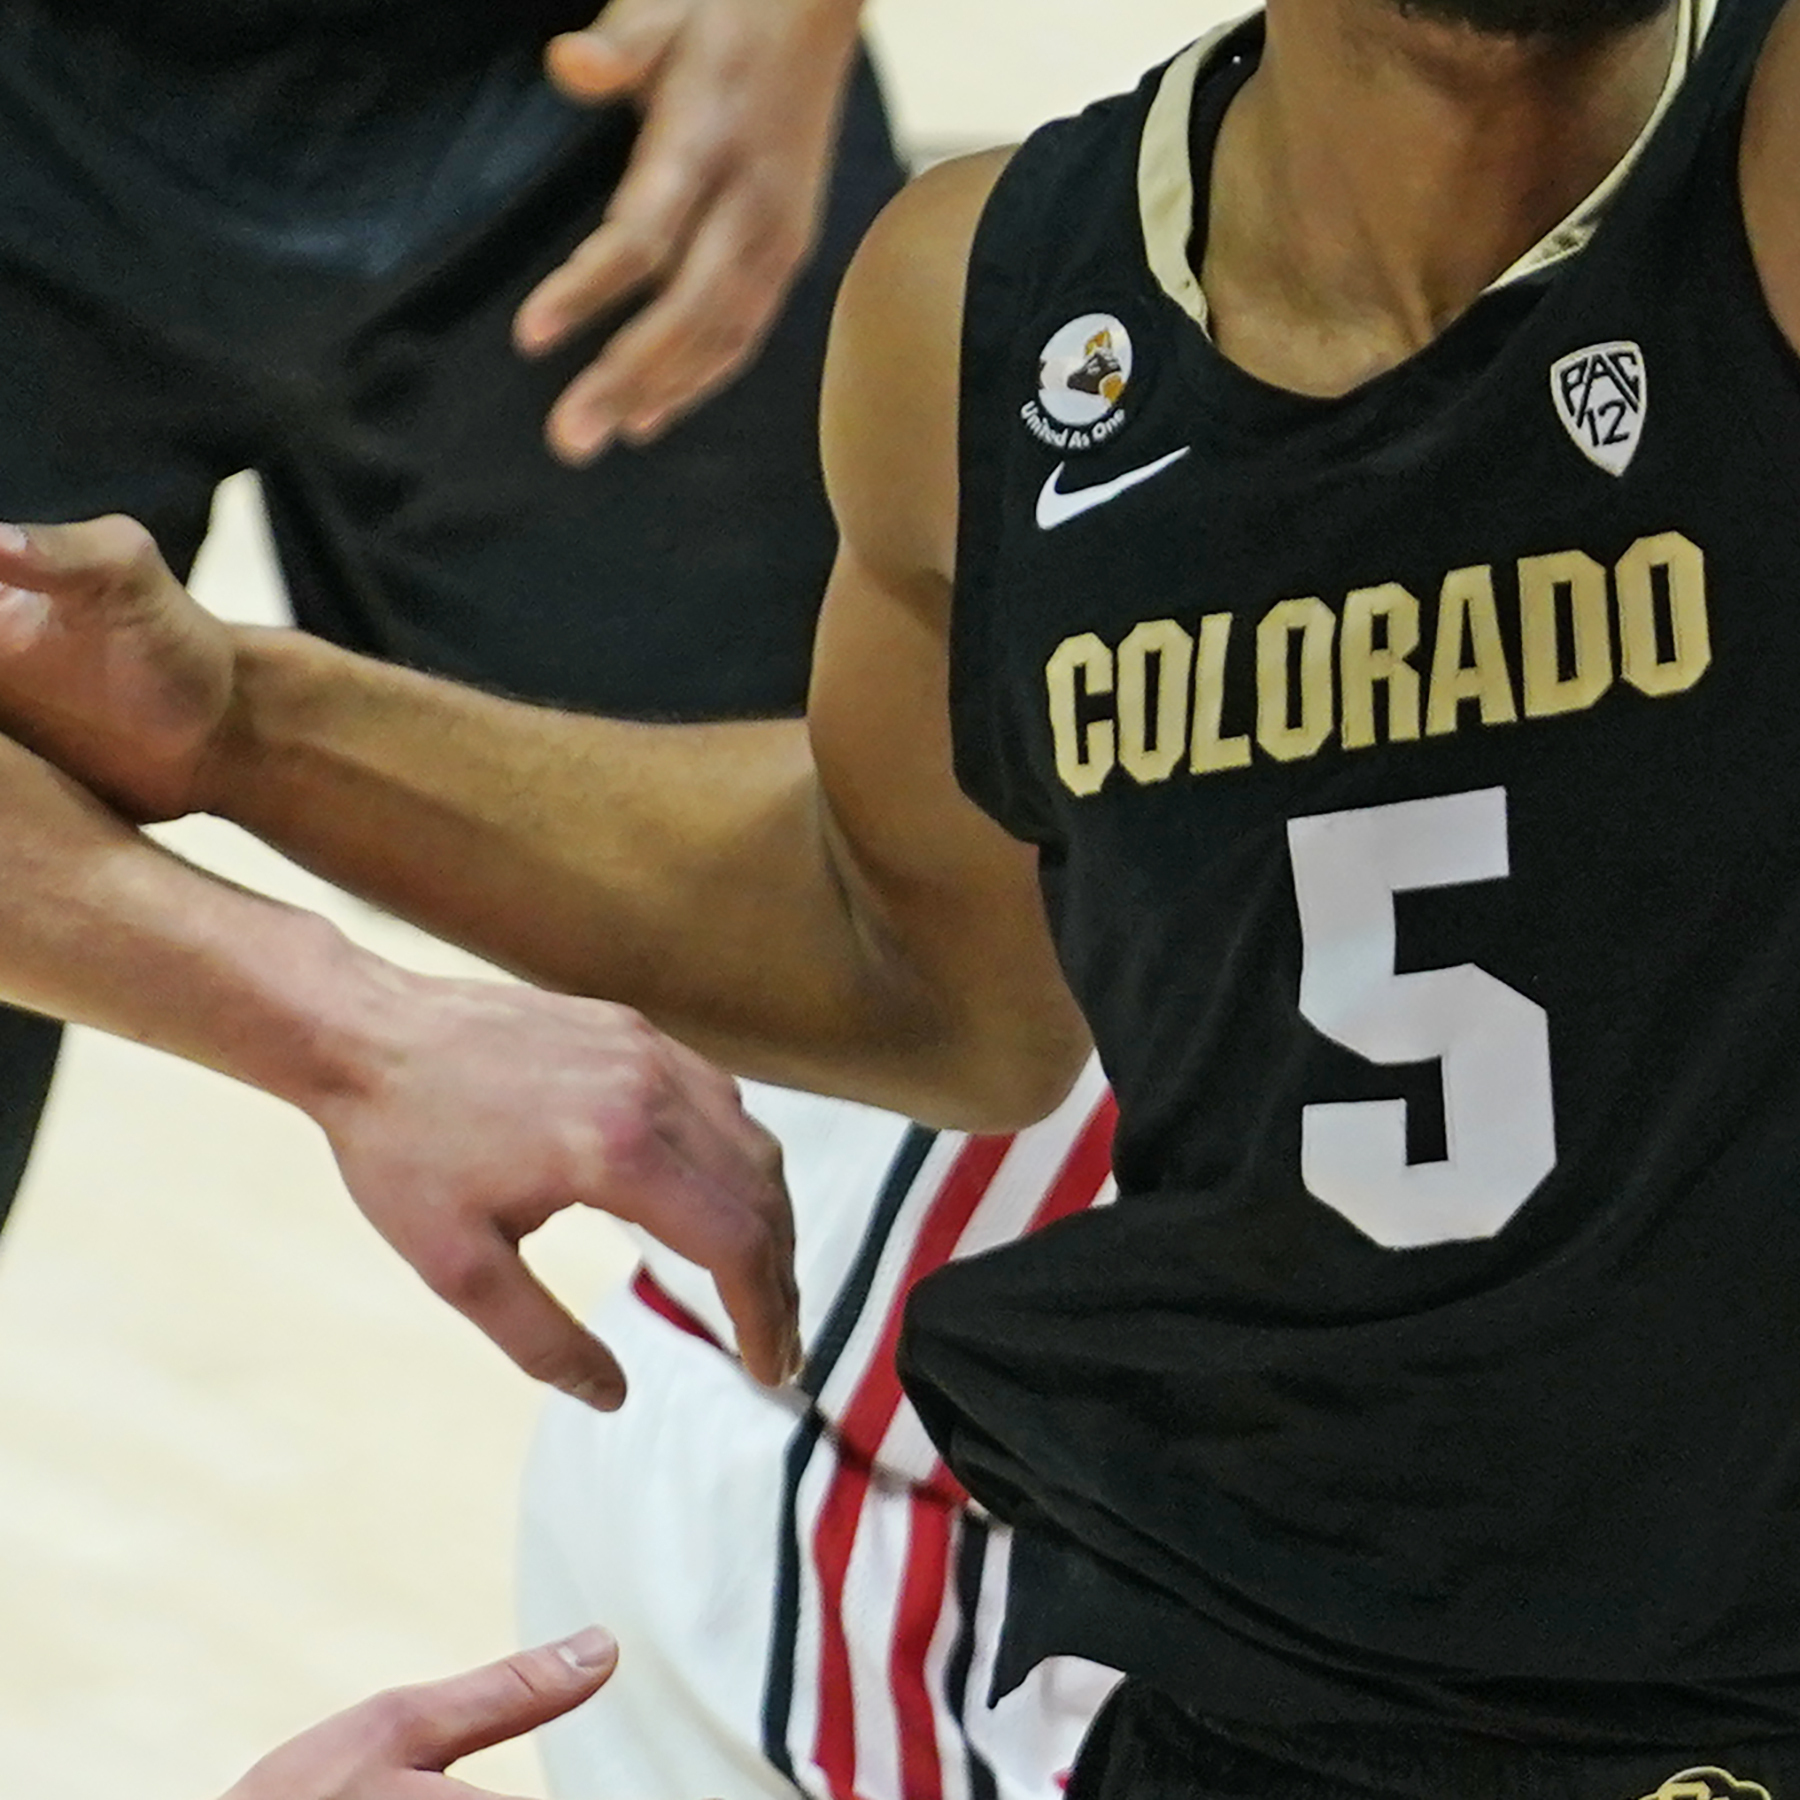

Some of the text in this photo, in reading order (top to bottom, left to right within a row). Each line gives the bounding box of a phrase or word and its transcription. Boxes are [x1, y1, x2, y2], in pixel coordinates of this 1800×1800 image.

[1020, 400, 1126, 450] United As One
[1560, 352, 1639, 428] PAC
[1583, 400, 1630, 448] 12
[1046, 531, 1713, 798] COLORADO
[1286, 786, 1557, 1251] 5
